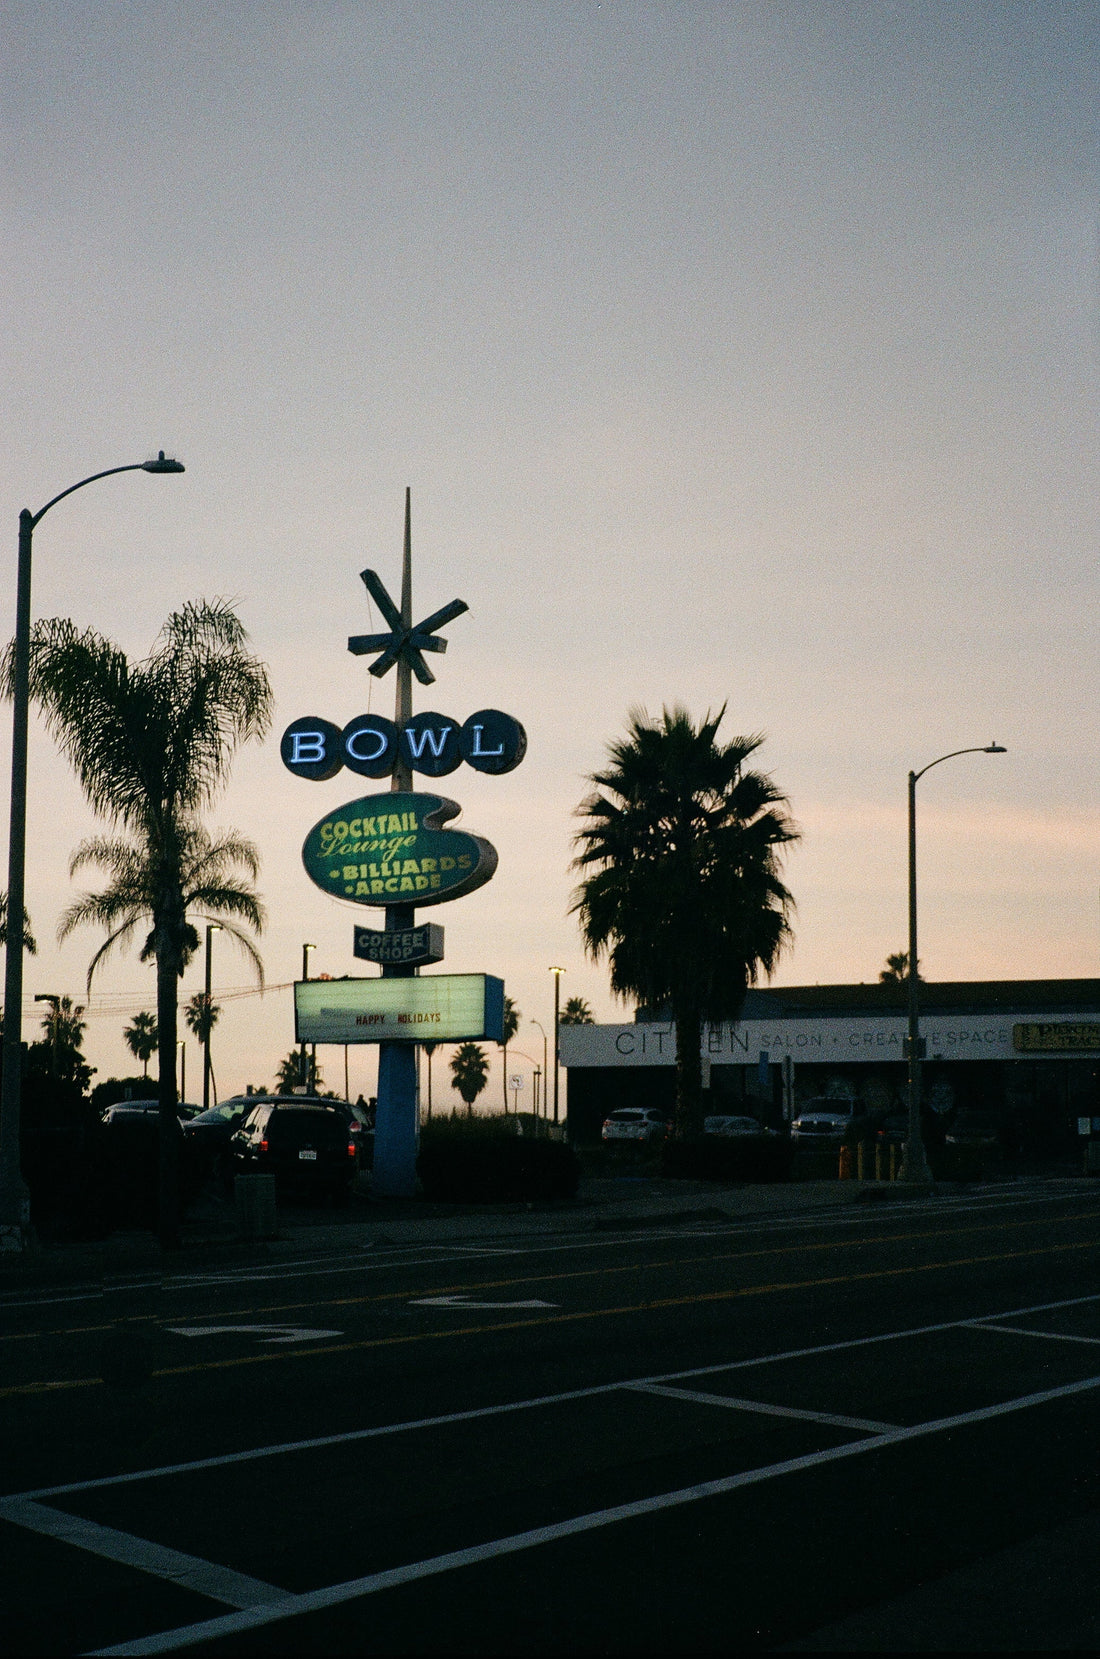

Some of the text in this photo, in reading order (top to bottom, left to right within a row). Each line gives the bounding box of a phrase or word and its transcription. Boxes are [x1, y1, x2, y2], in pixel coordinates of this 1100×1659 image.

[290, 725, 503, 763] BOWL
[320, 812, 419, 839] COCKTAIL
[317, 834, 417, 862] Lounge
[342, 854, 472, 880] BILLIARDS
[356, 873, 441, 896] ARCADE
[358, 931, 426, 948] COFFEE
[368, 946, 413, 960] SHOP
[356, 1012, 441, 1026] HAPPY HOLIDAYS
[615, 1030, 749, 1055] CITEN
[761, 1033, 822, 1048] SALON
[947, 1030, 1008, 1045] SPACE
